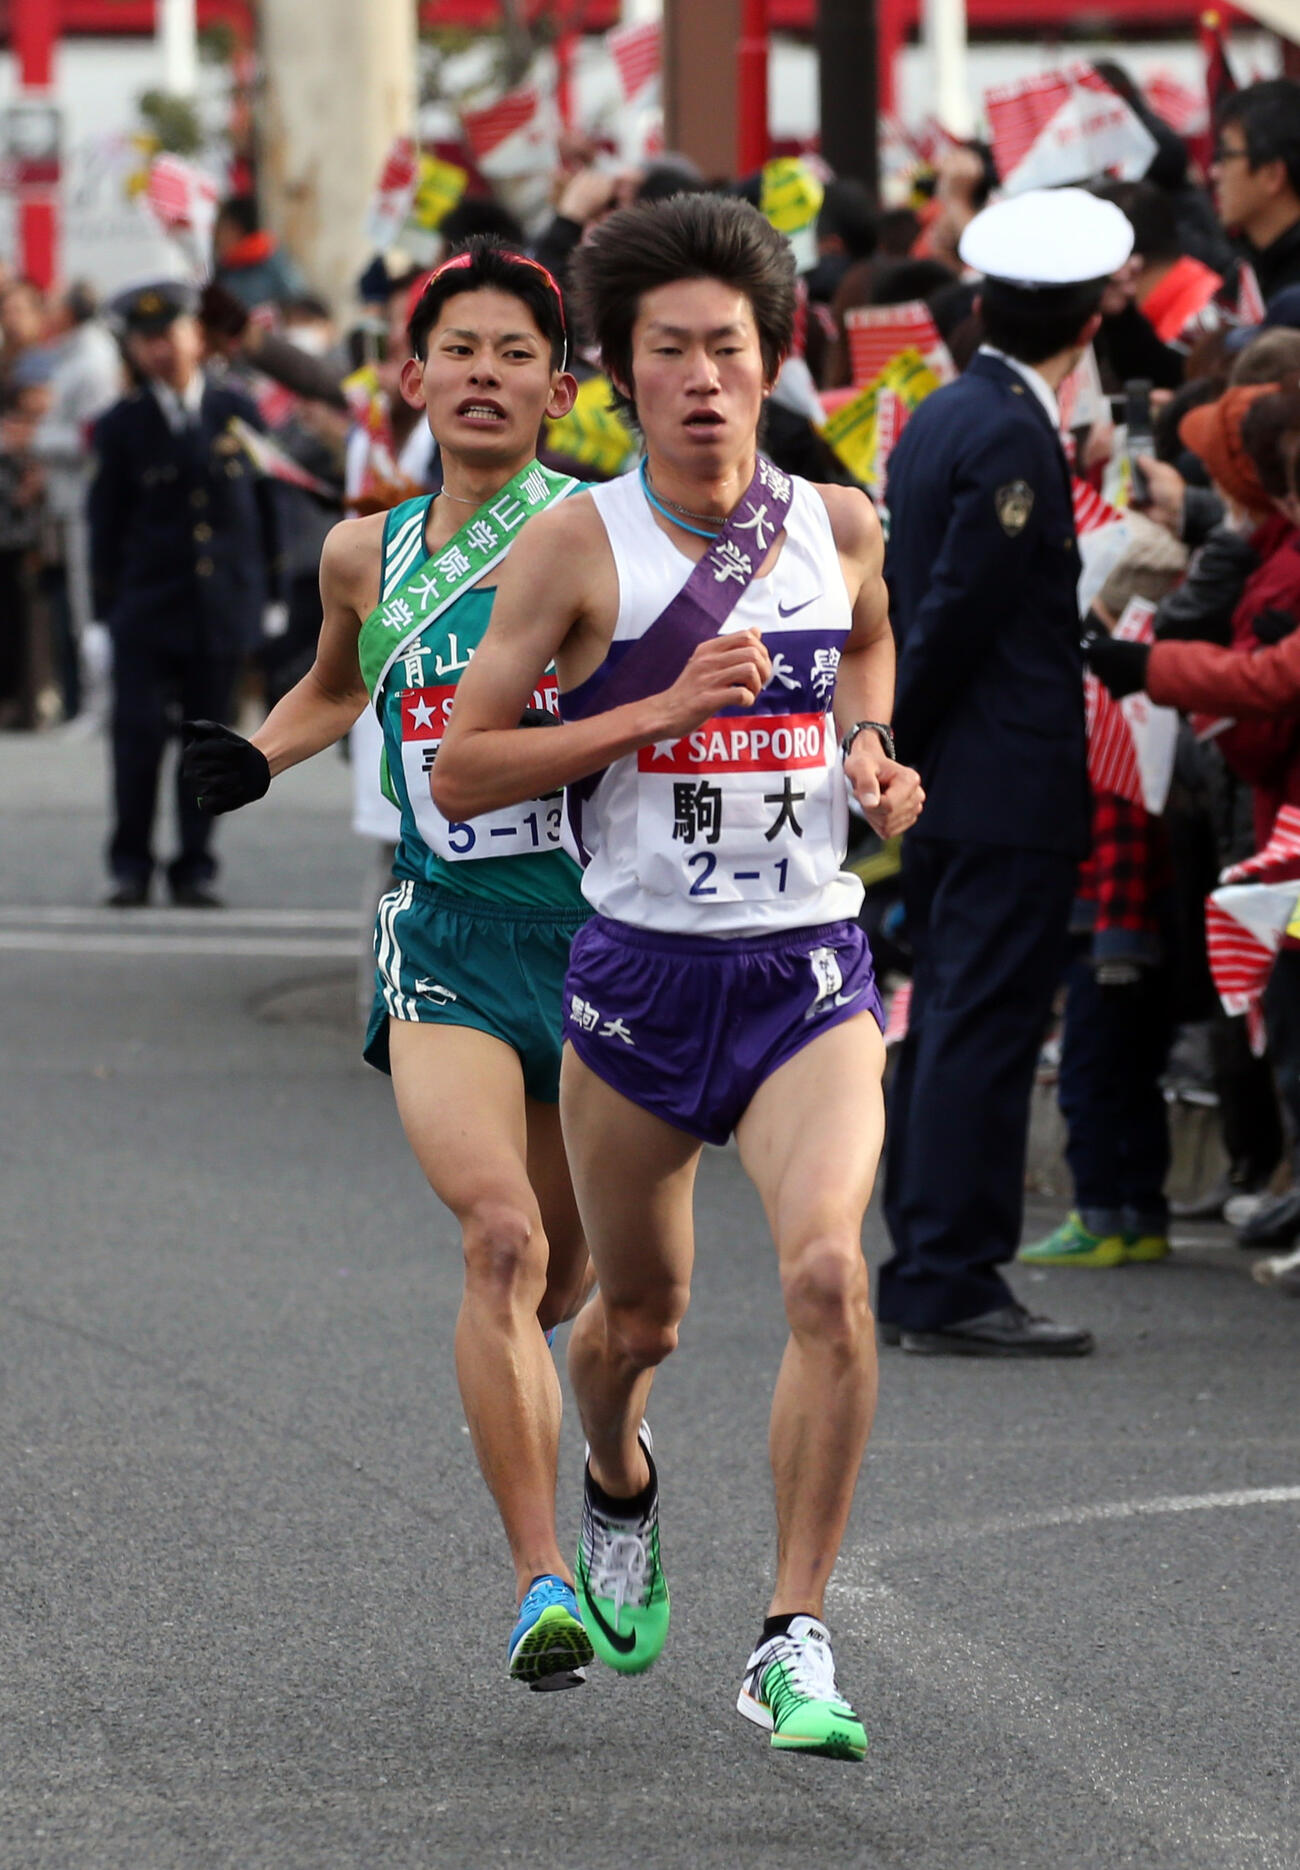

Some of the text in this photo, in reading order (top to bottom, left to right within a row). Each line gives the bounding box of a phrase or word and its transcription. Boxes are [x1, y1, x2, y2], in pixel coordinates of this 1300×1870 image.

[381, 468, 551, 632] 青山学院大学
[688, 725, 820, 762] SAPPORO
[448, 808, 563, 854] 5-13
[688, 851, 788, 896] 2-1
[570, 994, 635, 1046] 駒大
